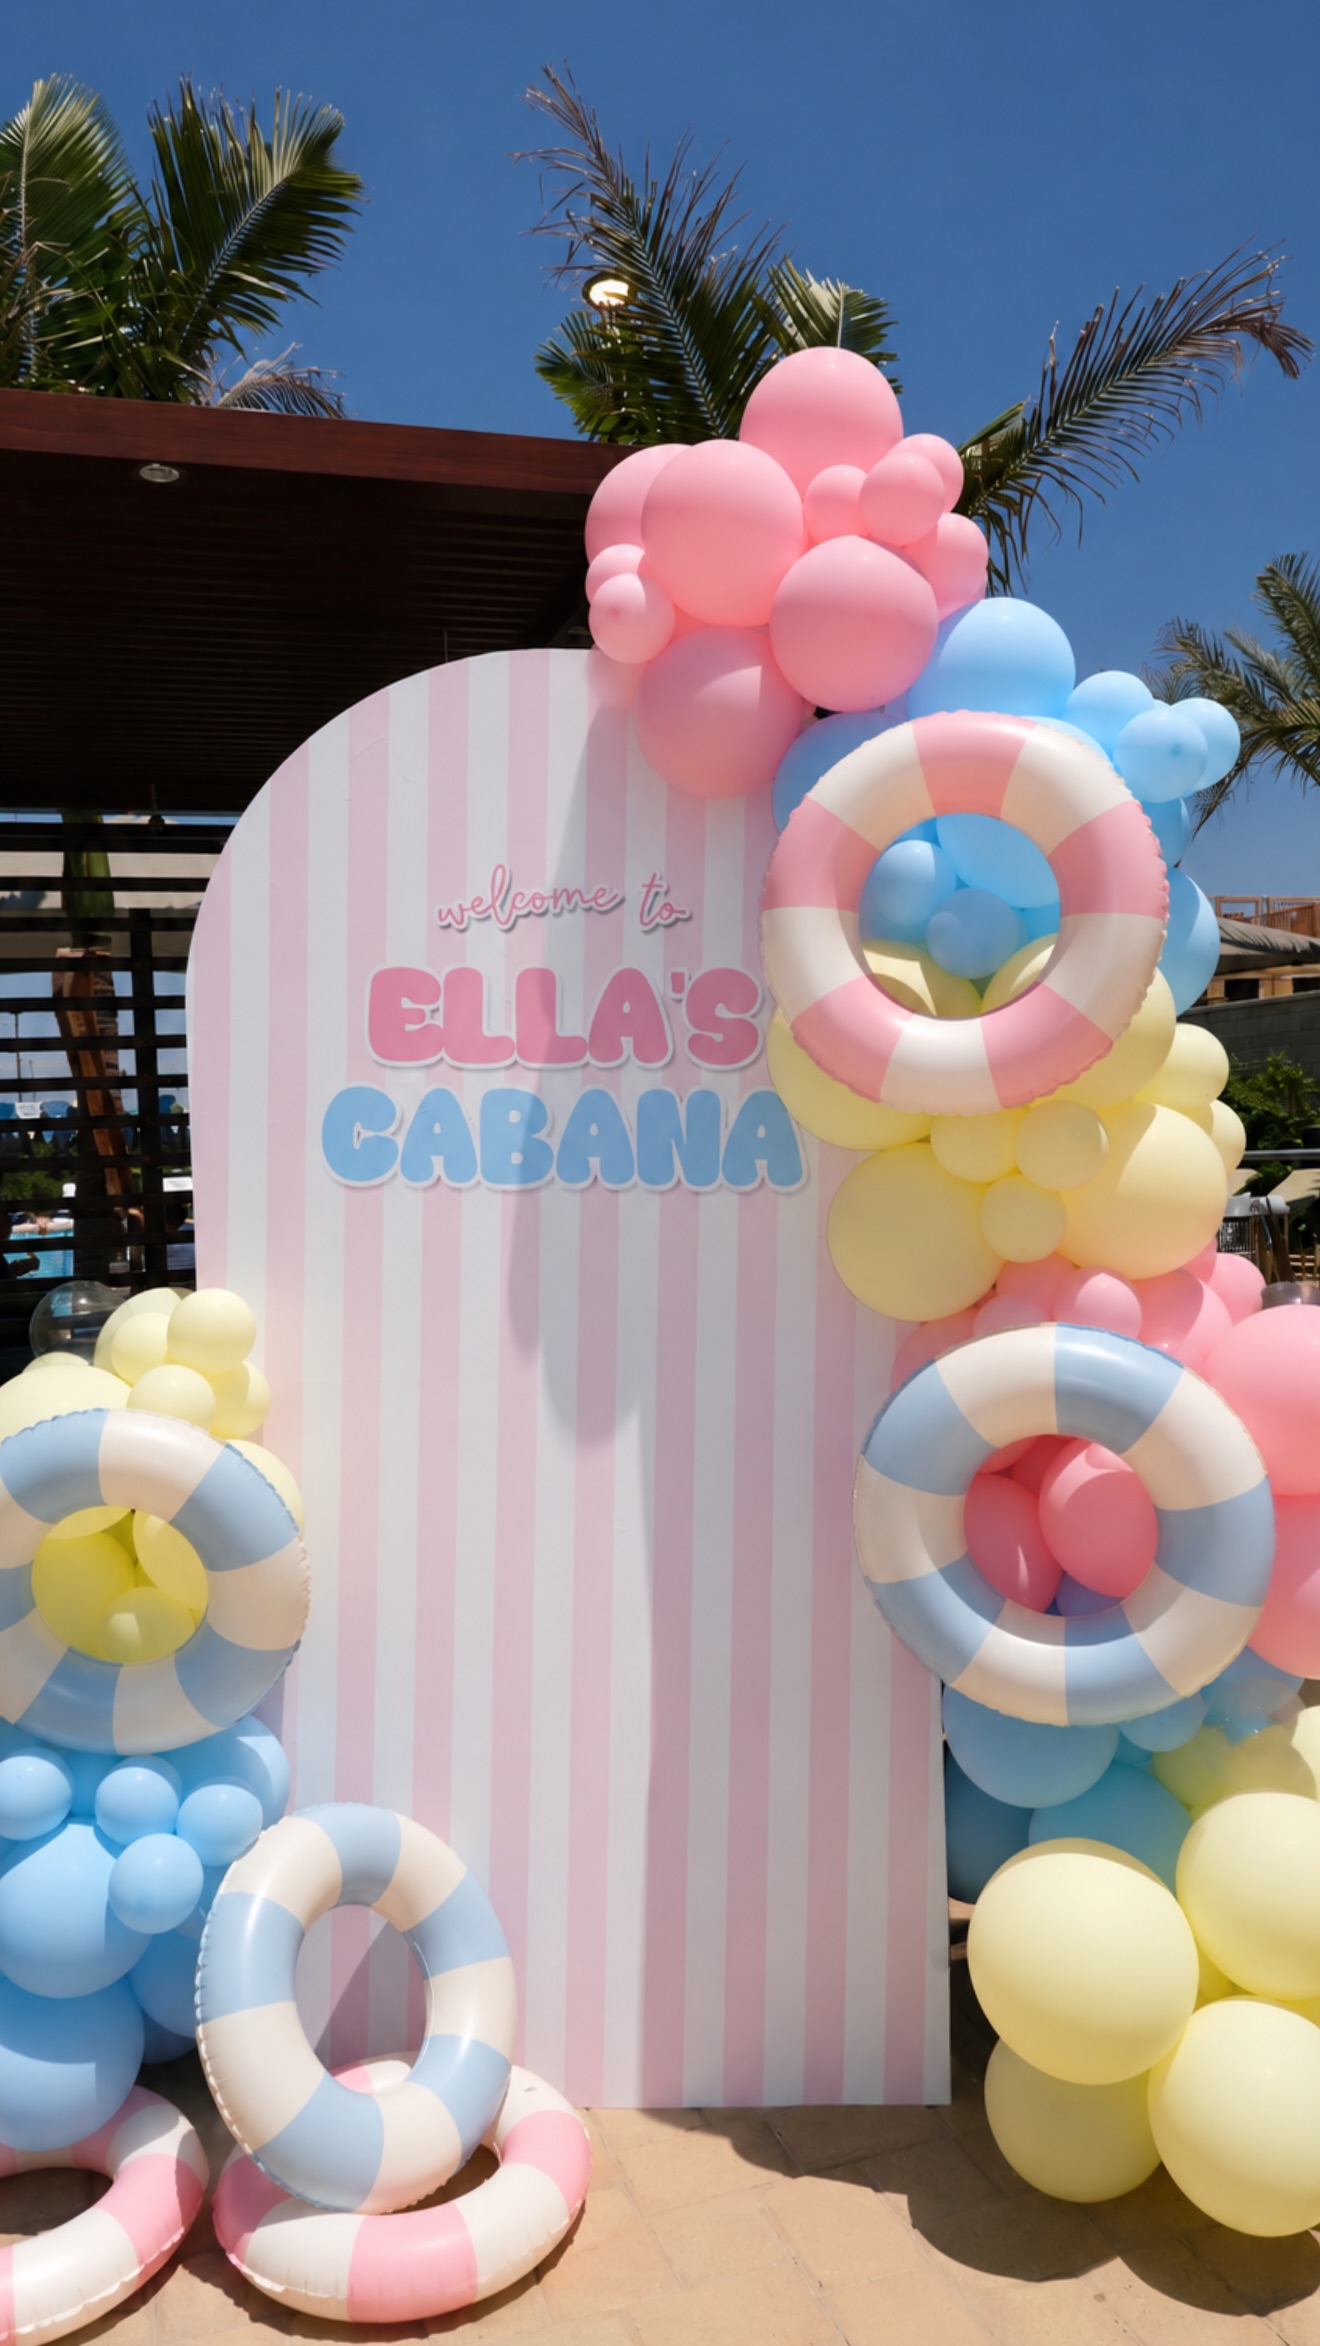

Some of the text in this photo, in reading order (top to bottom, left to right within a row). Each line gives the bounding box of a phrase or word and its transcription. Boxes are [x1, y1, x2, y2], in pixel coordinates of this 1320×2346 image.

[437, 863, 689, 929] welcome to
[367, 966, 761, 1066] ELLA'S
[321, 1085, 804, 1188] CABANA
